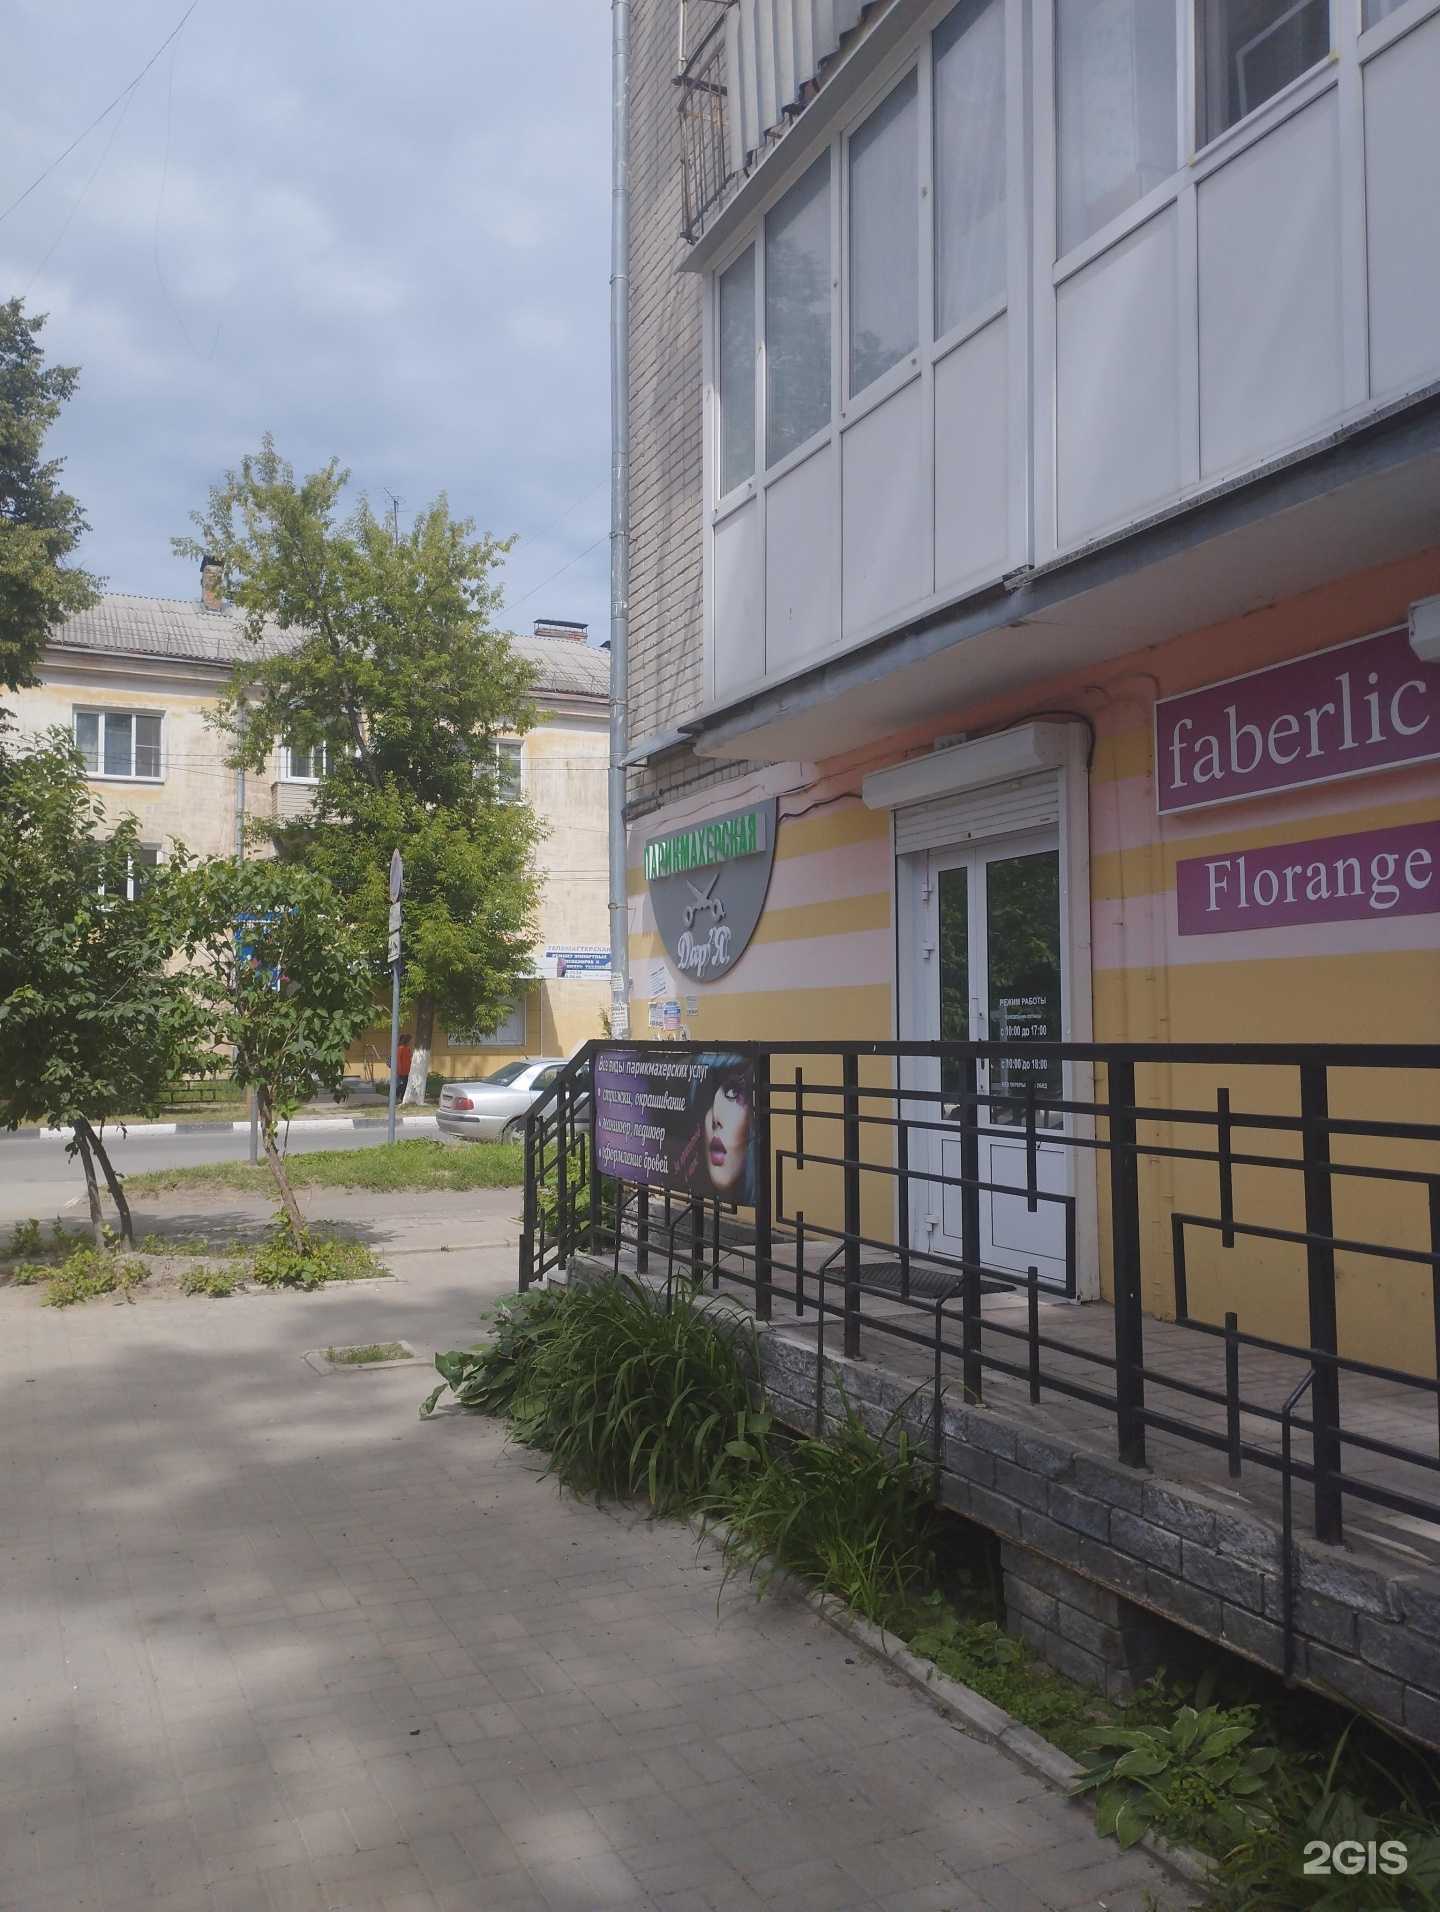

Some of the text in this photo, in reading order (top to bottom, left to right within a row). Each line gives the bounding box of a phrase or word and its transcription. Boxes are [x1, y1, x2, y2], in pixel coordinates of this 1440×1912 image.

[1169, 671, 1430, 789] faberlic
[1204, 847, 1433, 912] Florange
[1000, 996, 1047, 1007] РЕЖИМ РАБОТЫ
[1021, 1028, 1030, 1037] до
[1031, 1024, 1047, 1036] 17:00
[598, 1056, 709, 1083] Все виды парикмахерских услуг
[1022, 1061, 1030, 1071] до
[1031, 1059, 1048, 1070] 18:00
[635, 1090, 686, 1115] окрашивание
[643, 1151, 669, 1178] бровей
